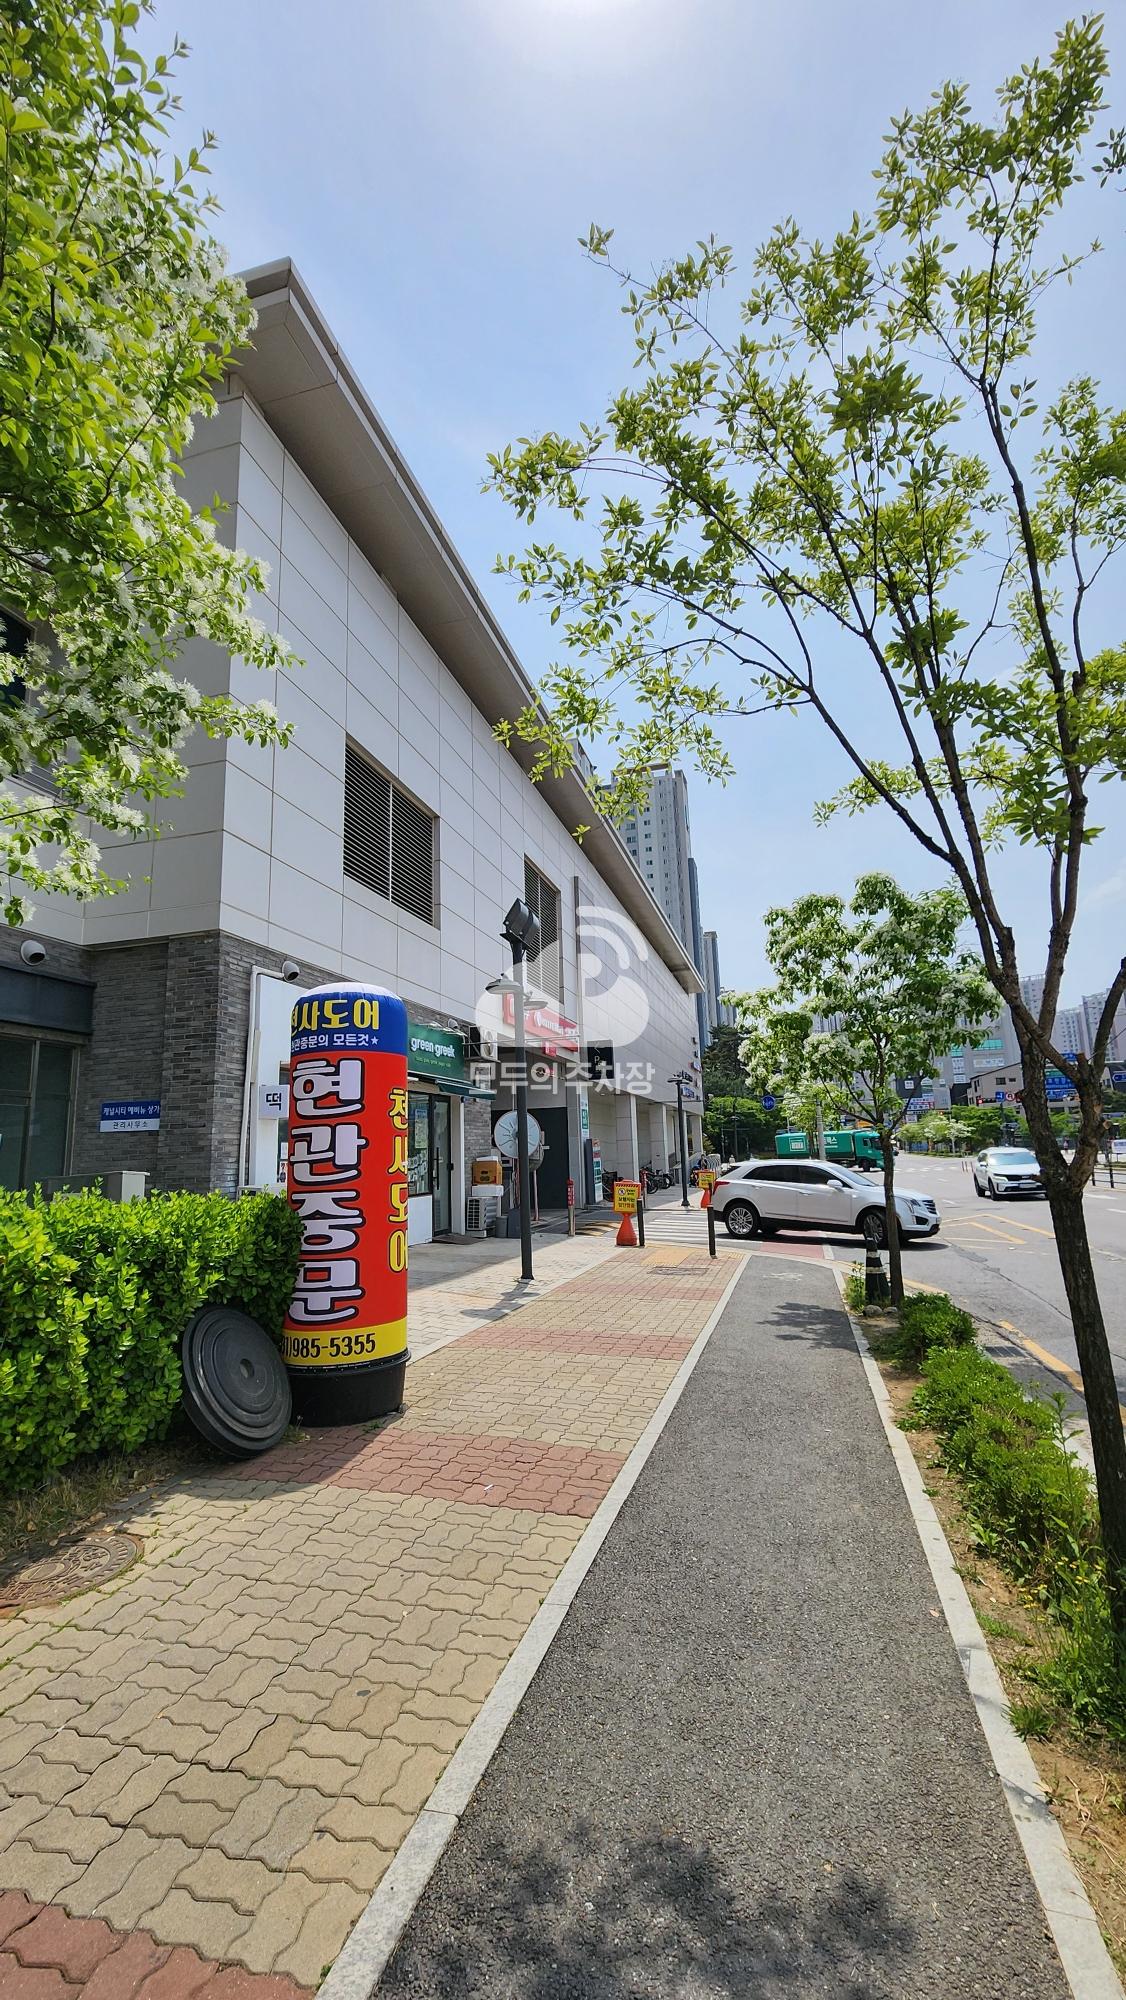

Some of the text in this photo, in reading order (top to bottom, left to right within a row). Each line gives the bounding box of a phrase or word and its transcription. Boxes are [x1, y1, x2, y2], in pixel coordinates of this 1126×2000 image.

[291, 999, 380, 1036] 사도어
[333, 1034, 369, 1046] 모든것
[411, 1037, 456, 1058] green greek
[147, 1105, 160, 1114] 상가
[265, 1092, 282, 1111] 떡
[290, 1058, 367, 1325] 현관중문
